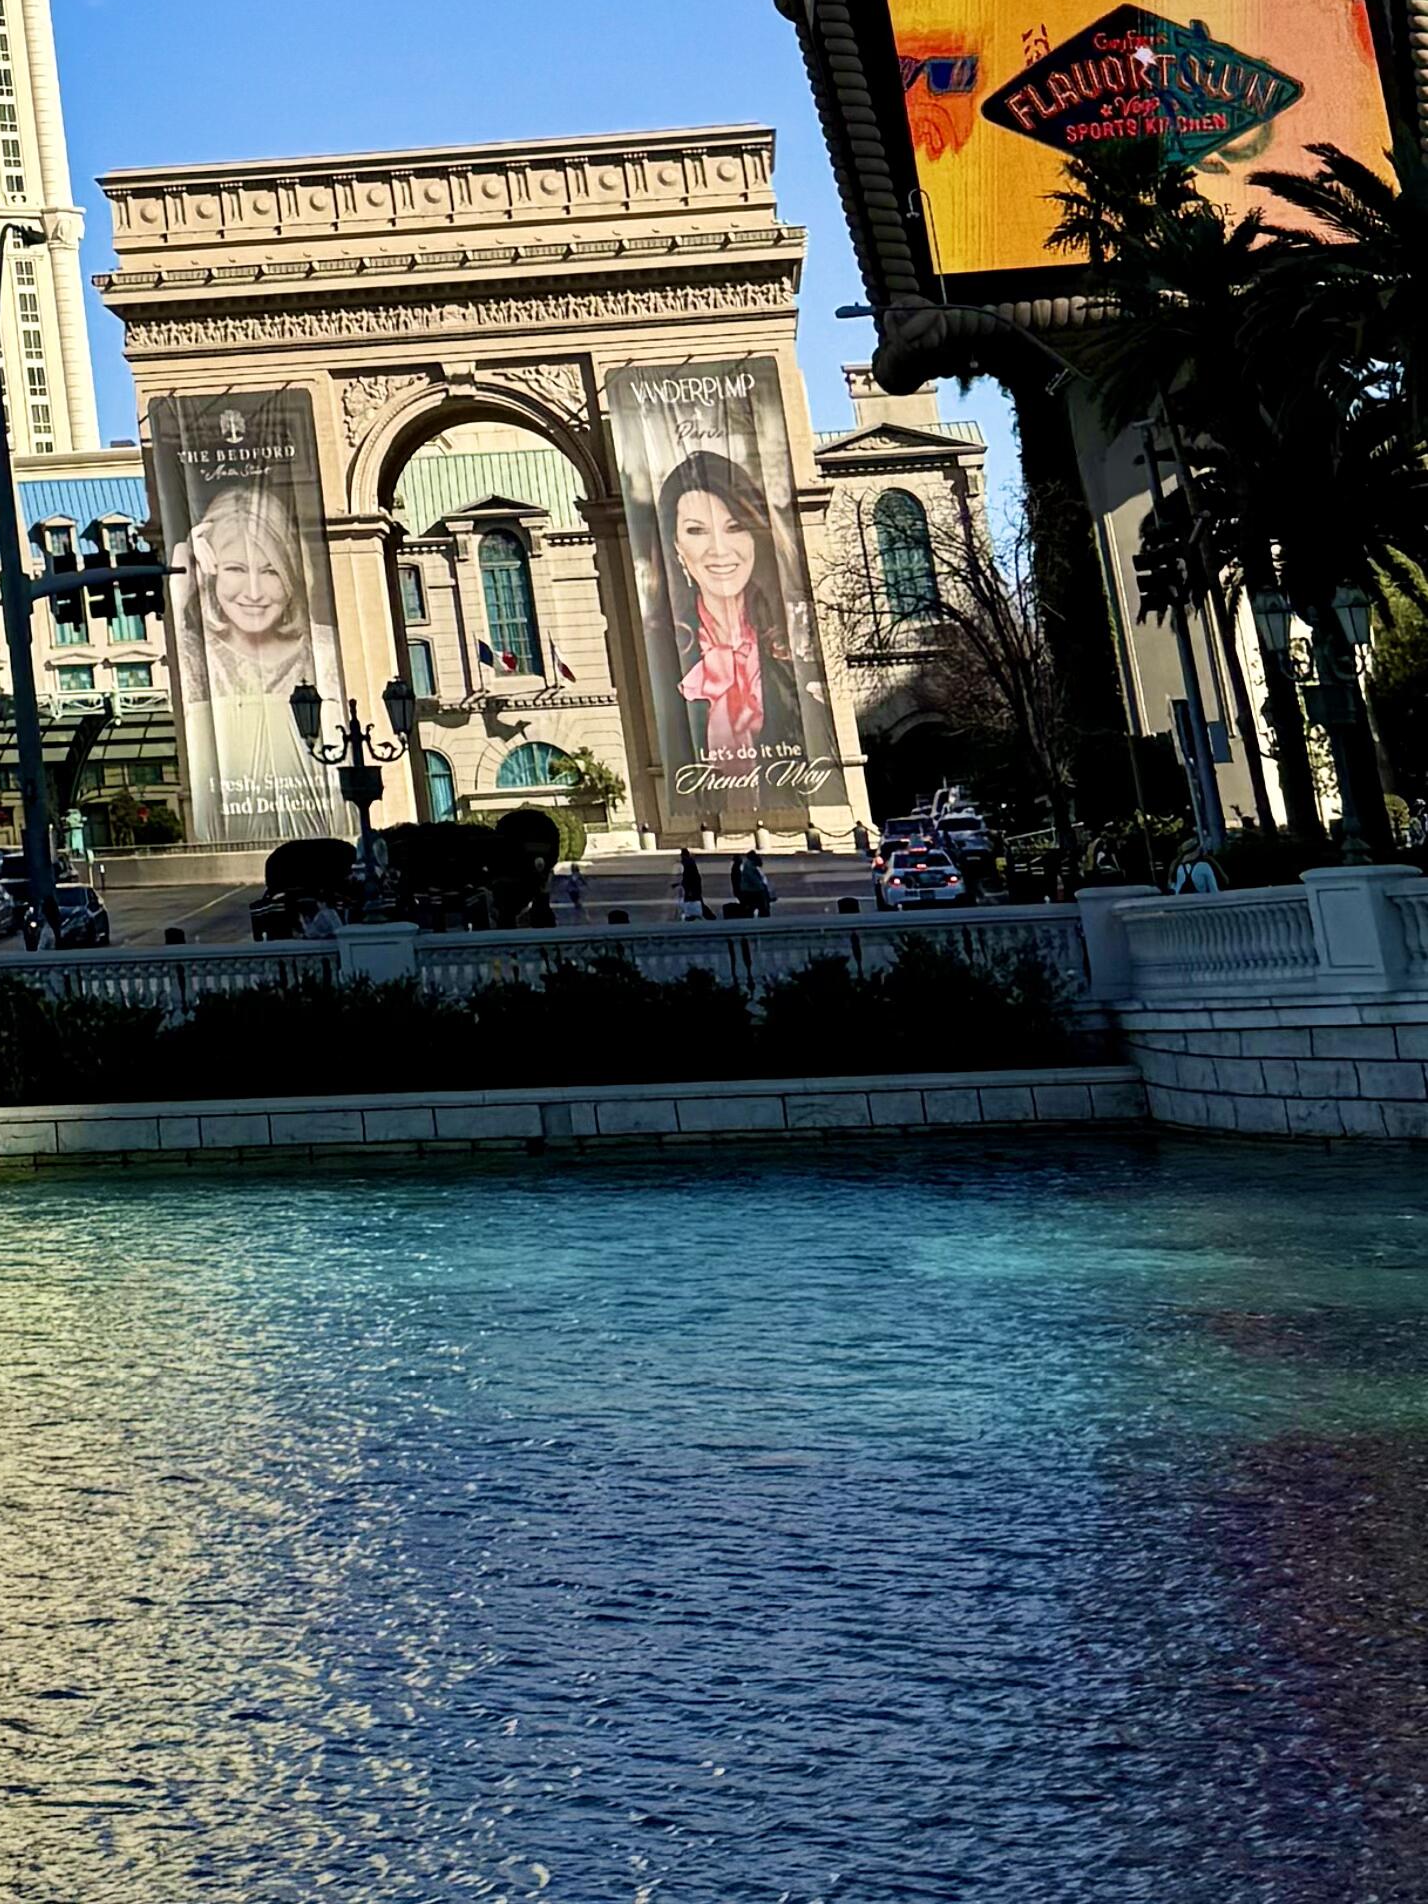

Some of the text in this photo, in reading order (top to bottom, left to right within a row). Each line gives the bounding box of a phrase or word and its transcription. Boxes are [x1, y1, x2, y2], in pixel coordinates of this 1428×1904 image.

[1066, 119, 1137, 143] SPORTS
[176, 444, 296, 464] THE BEDFORD
[700, 741, 802, 762] Let's do it the
[675, 756, 833, 795] French Way
